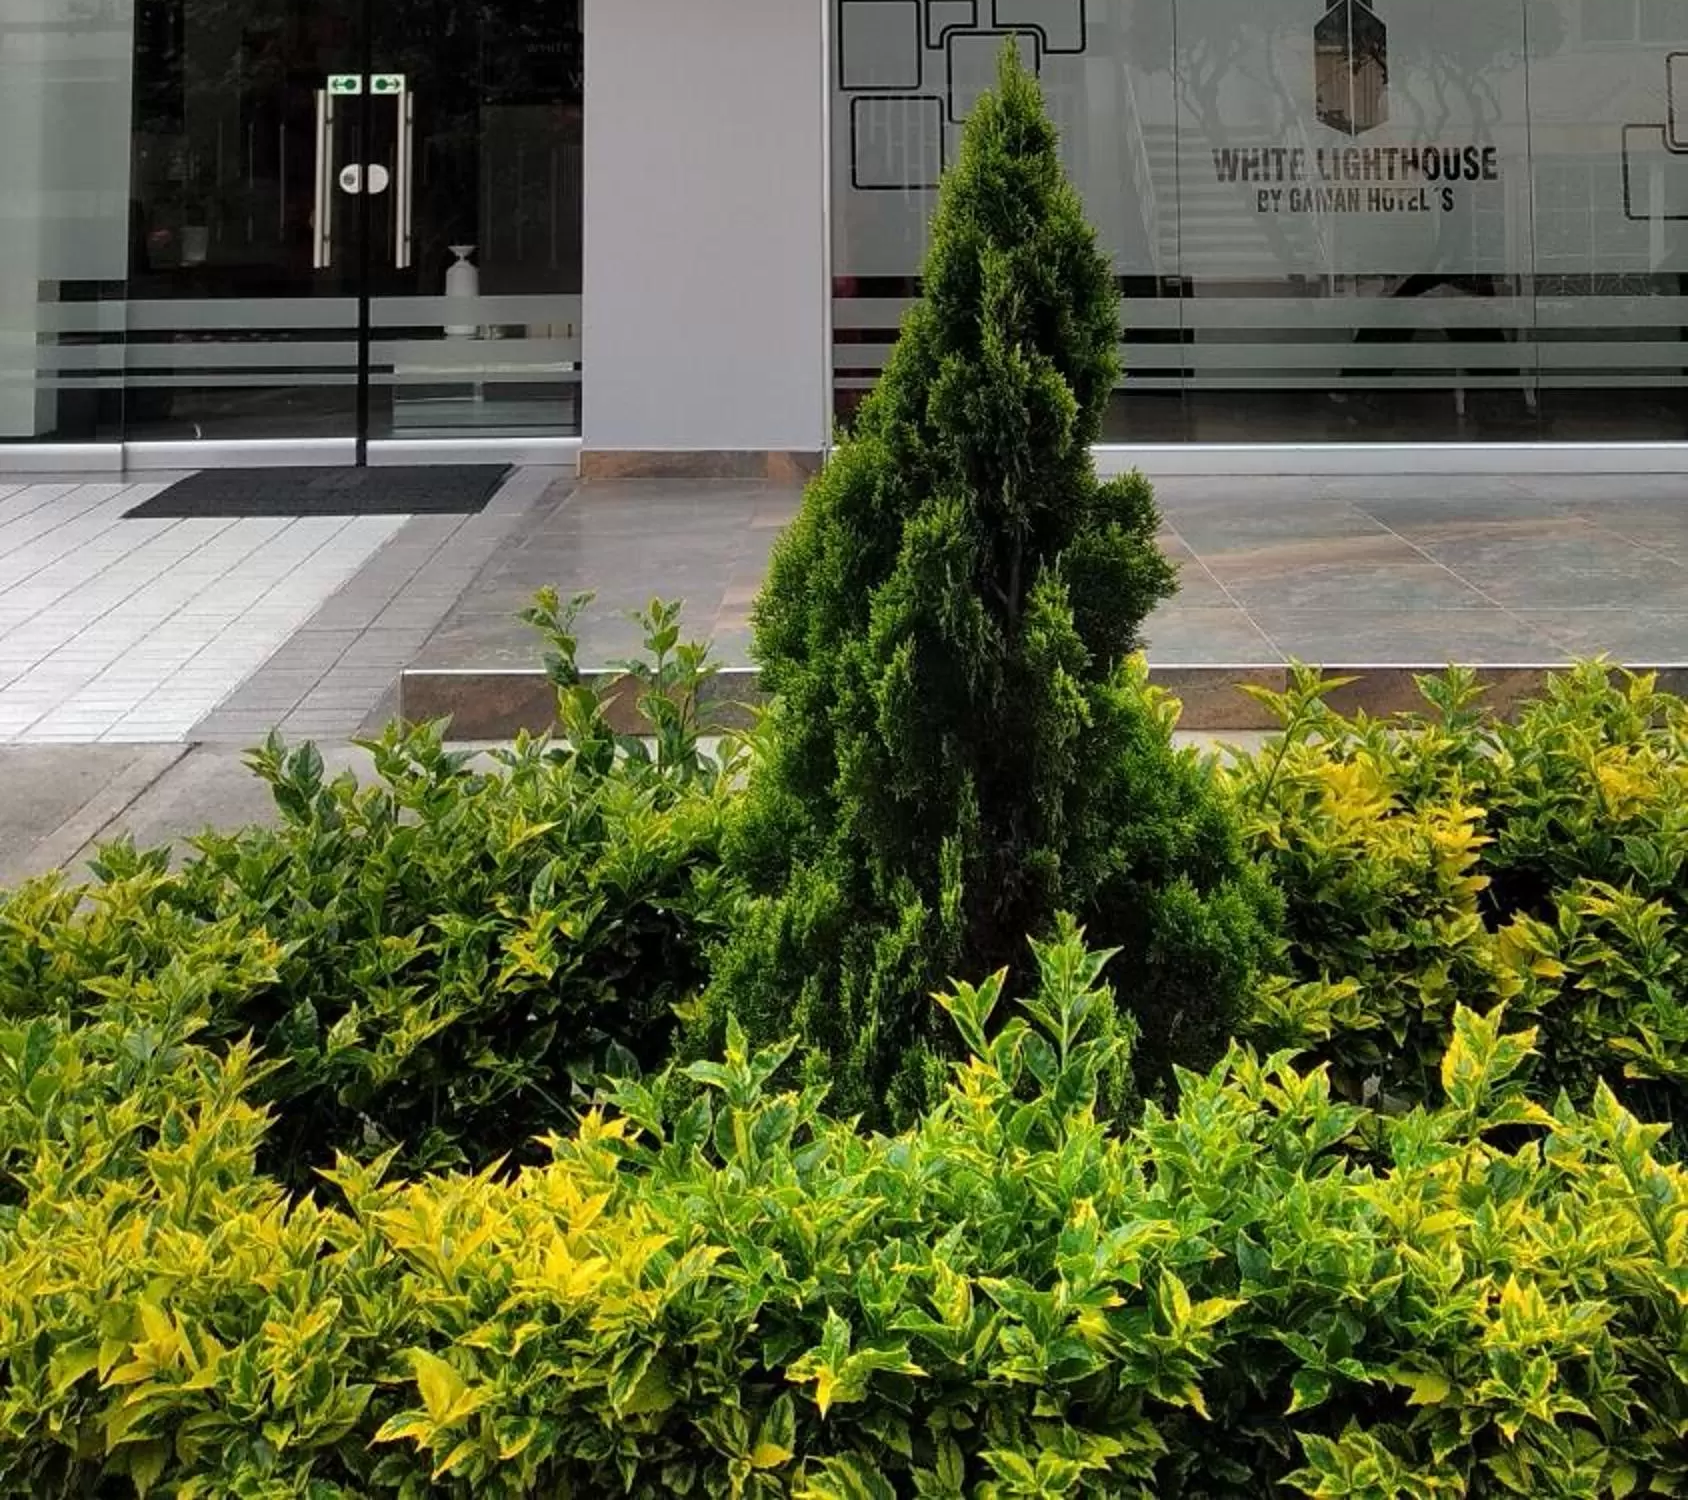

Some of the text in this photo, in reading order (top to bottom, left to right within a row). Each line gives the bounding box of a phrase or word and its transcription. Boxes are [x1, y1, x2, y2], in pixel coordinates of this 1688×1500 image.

[1212, 145, 1498, 182] WHITE LIGHTHOUSE
[1257, 188, 1282, 213] BY
